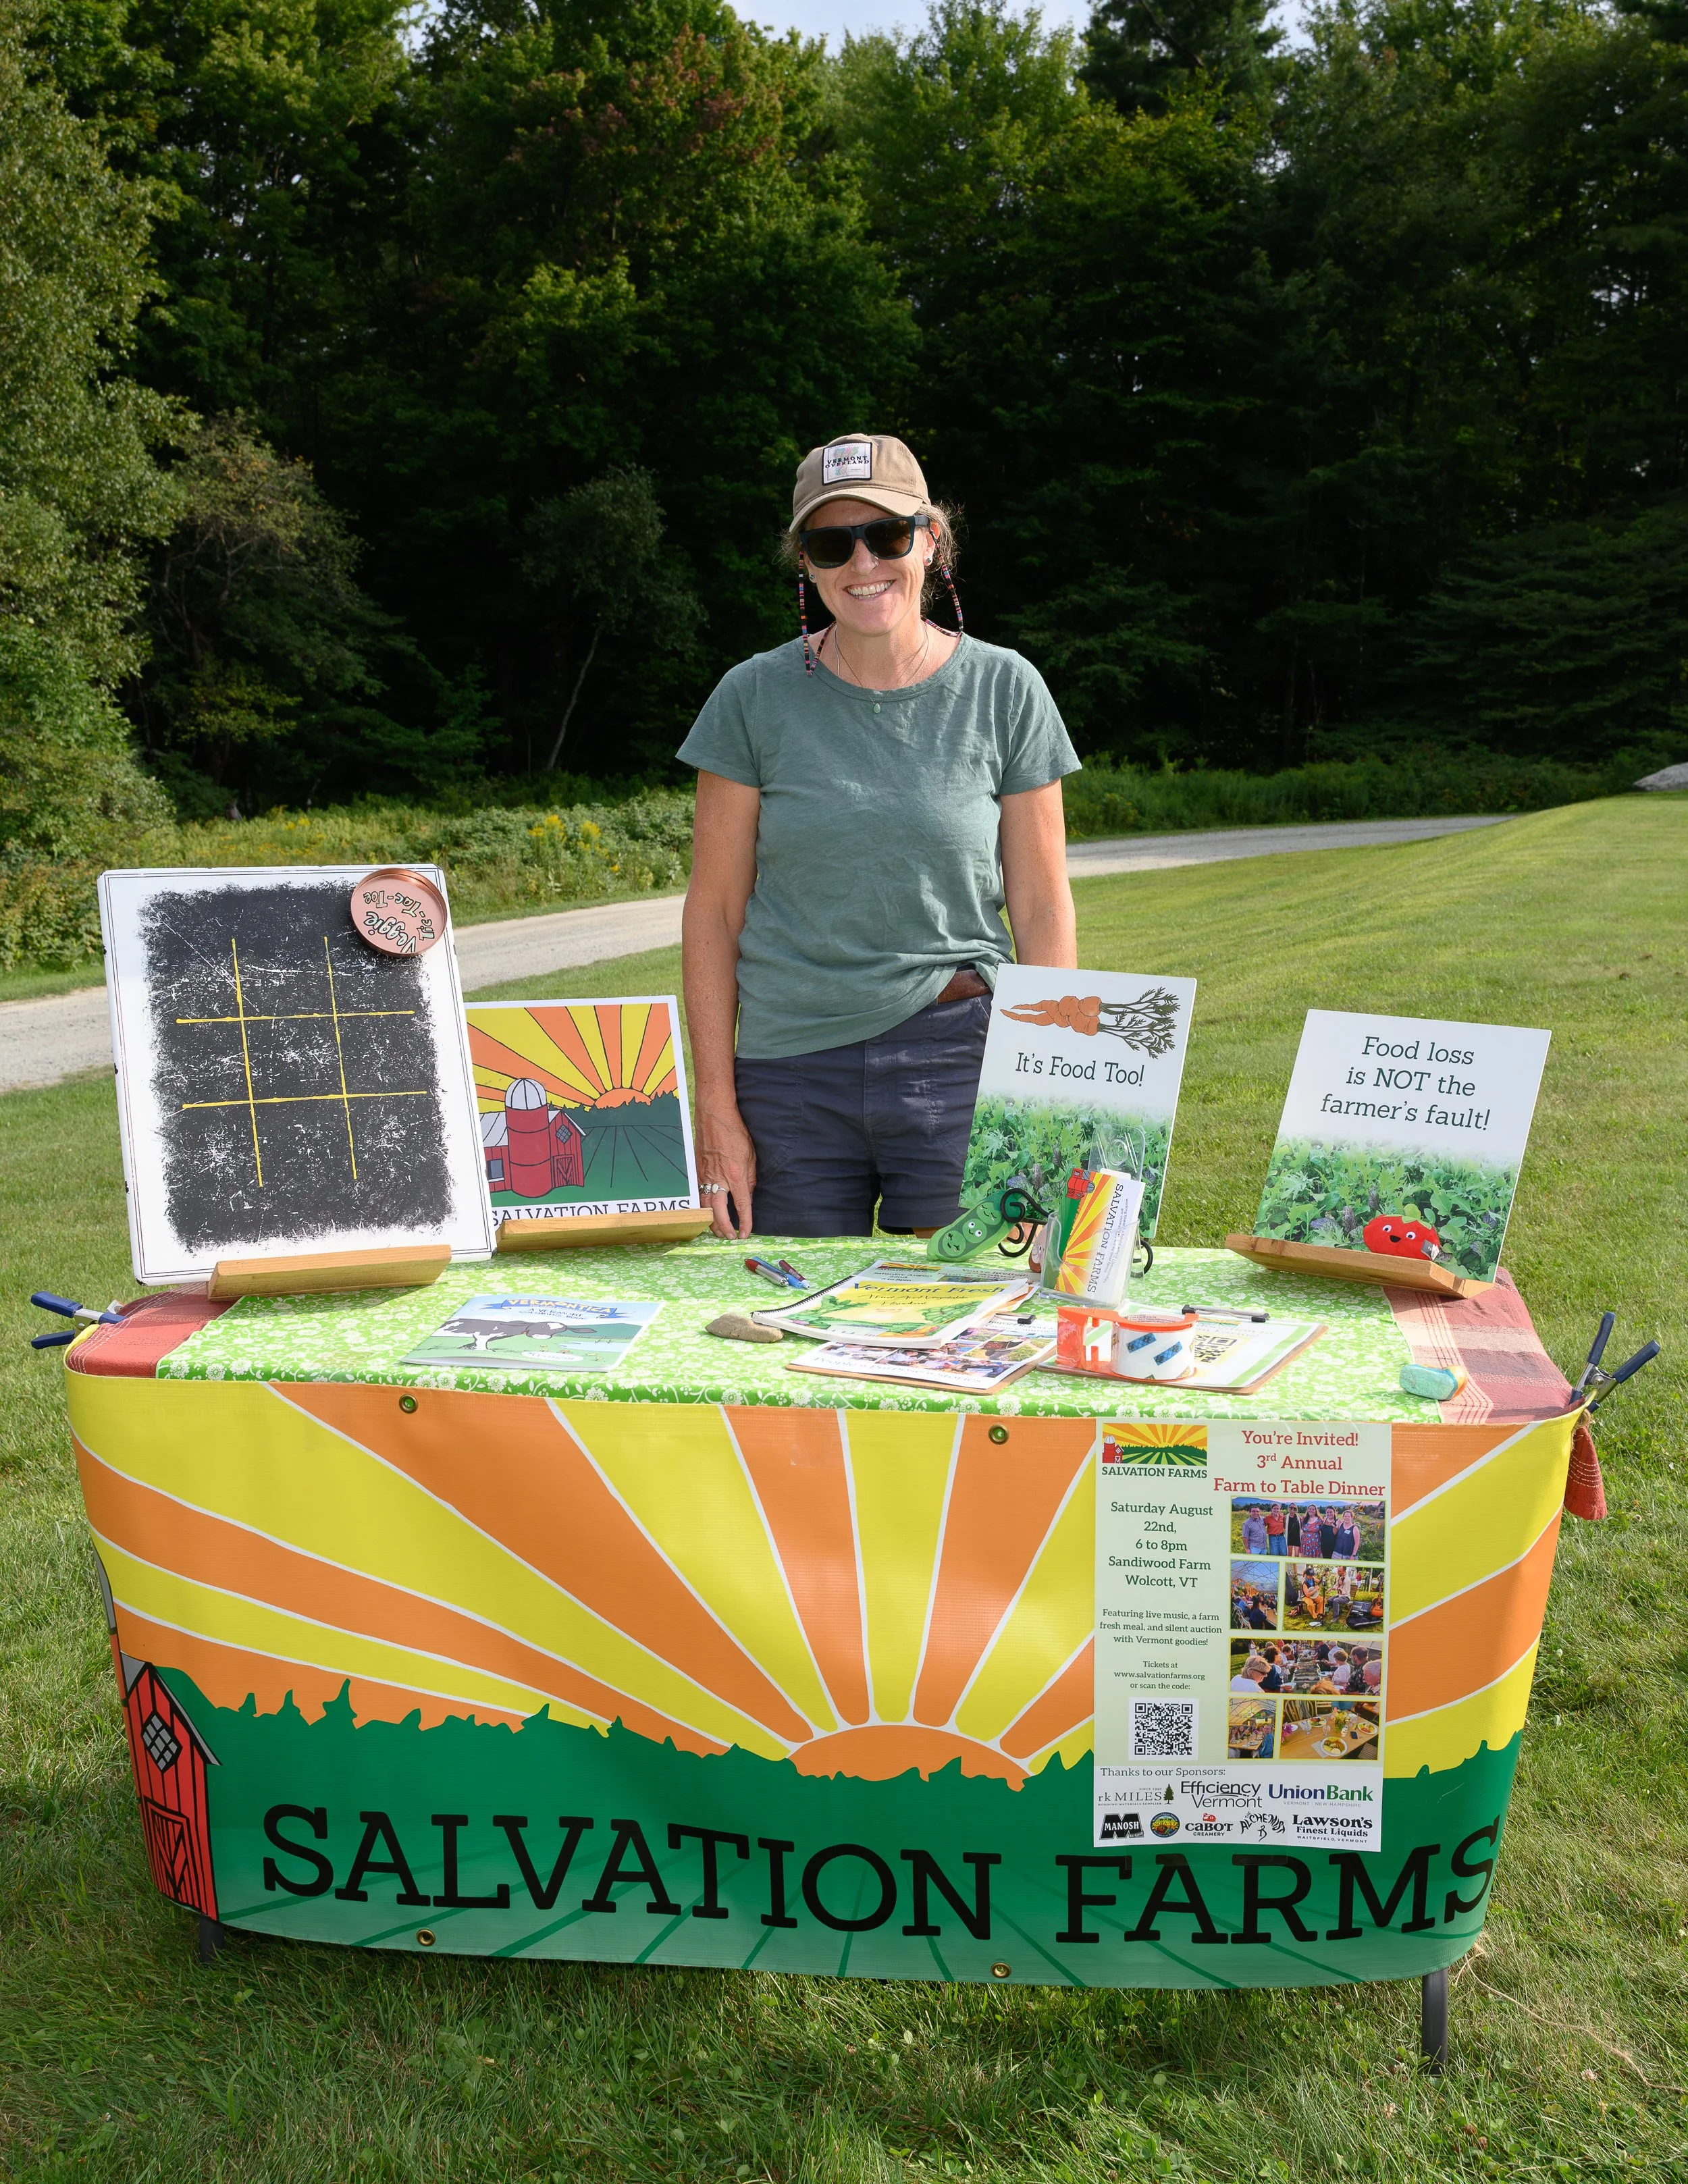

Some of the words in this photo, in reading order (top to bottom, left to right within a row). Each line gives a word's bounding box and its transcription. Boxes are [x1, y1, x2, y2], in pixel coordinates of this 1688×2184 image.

[825, 460, 869, 469] OVERLAND
[363, 911, 417, 953] Veggie
[1362, 1036, 1419, 1060] Food
[1427, 1042, 1475, 1065] loss
[1016, 1053, 1042, 1075] It's
[1049, 1057, 1096, 1081] Food
[1105, 1062, 1145, 1087] Too!
[1346, 1067, 1365, 1086] is
[1373, 1068, 1431, 1091] NOT
[1438, 1075, 1476, 1096] the
[1320, 1094, 1419, 1122] farmer's
[1425, 1104, 1491, 1131] fault!
[1101, 1183, 1124, 1249] SALVATION
[1087, 1252, 1105, 1293] FARMS
[854, 1283, 941, 1293] Vermont
[507, 1299, 612, 1314] VERMONTICA
[1242, 1430, 1293, 1445] You're
[1296, 1432, 1359, 1446] Invited!
[1257, 1454, 1277, 1469] 3rd
[1280, 1455, 1343, 1470] Annual
[1101, 1466, 1165, 1477] SALVATION
[1167, 1468, 1207, 1479] FARMS
[1213, 1478, 1257, 1493] Farm
[1260, 1481, 1277, 1493] to
[1280, 1479, 1324, 1494] Table
[1328, 1481, 1386, 1496] Dinner
[1111, 1501, 1166, 1516] Saturday
[1169, 1504, 1213, 1517] August
[1144, 1521, 1177, 1534] 22nd,
[1135, 1539, 1143, 1549] 6
[1146, 1539, 1158, 1550] to
[1161, 1540, 1188, 1552] 8pm
[1108, 1555, 1176, 1569] Sandiwood
[1179, 1559, 1211, 1570] Farm
[1125, 1574, 1176, 1589] Wolcott,
[1179, 1577, 1198, 1587] VT
[1102, 1609, 1144, 1619] Featuring
[1146, 1610, 1161, 1618] live
[1163, 1612, 1190, 1620] music,
[1198, 1612, 1220, 1621] farm
[1099, 1622, 1121, 1630] fresh
[1123, 1623, 1146, 1632] meal,
[1147, 1624, 1163, 1632] and
[1165, 1624, 1188, 1632] silent
[1113, 1635, 1134, 1643] with
[1136, 1636, 1173, 1645] Vermont
[1175, 1637, 1209, 1646] goodies!
[1114, 1671, 1205, 1680] www.salvationfarms.org
[1101, 1767, 1140, 1776] Thanks
[1142, 1768, 1153, 1776] to
[1155, 1768, 1173, 1776] our
[1176, 1767, 1226, 1778] Sponsors:
[1181, 1780, 1261, 1797] Efficiency
[1269, 1784, 1373, 1801] UnionBank
[1098, 1792, 1111, 1802] rk
[1115, 1791, 1162, 1801] MILES
[1191, 1794, 1262, 1808] Vermont
[1104, 1821, 1140, 1831] MANOSH
[1240, 1813, 1286, 1835] ALCHEMIST
[1292, 1814, 1373, 1829] Lawson's
[1296, 1826, 1327, 1834] Finest
[1331, 1828, 1368, 1837] Liquids
[263, 1804, 1002, 1940] SALVATION
[1055, 1814, 1500, 1944] FARMS
